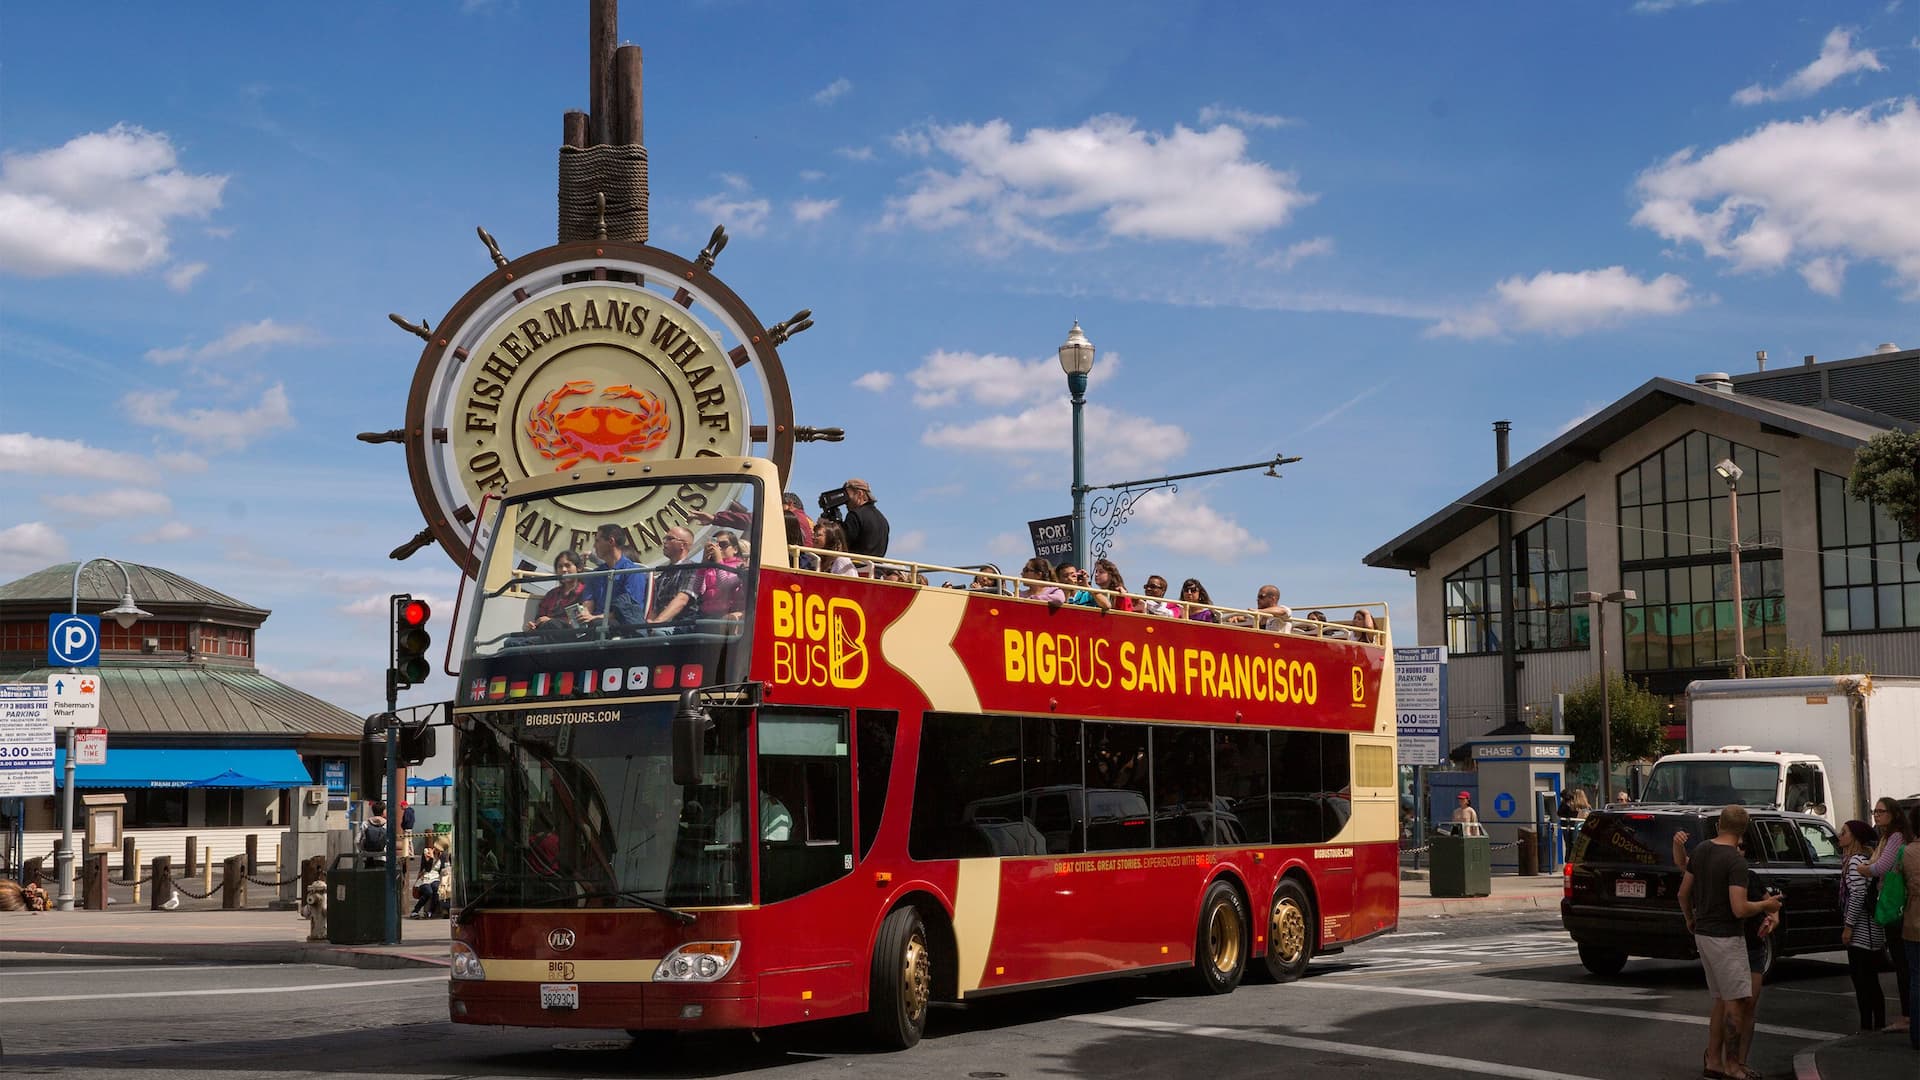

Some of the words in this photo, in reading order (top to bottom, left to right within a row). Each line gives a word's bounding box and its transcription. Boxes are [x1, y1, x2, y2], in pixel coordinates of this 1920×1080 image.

[466, 299, 649, 435] FISHERMANS
[650, 314, 731, 434] WHARF
[469, 451, 510, 491] OF
[1038, 524, 1066, 540] PORT
[1038, 546, 1050, 556] 150
[1051, 543, 1073, 554] YEARS
[773, 589, 827, 642] BIG
[774, 641, 828, 688] BUS
[1119, 641, 1176, 694] SAN
[1184, 648, 1318, 705] FRANCISCO
[53, 701, 95, 709] Fisherman's
[53, 709, 75, 717] Wharf
[526, 710, 621, 727] BIGBUSTOURS.COM
[1480, 747, 1512, 756] CHASE
[1534, 746, 1559, 756] CHASE
[1054, 861, 1075, 874] GREAT
[1097, 859, 1117, 871] GREAT
[1143, 856, 1181, 869] EXPERIENCED
[1181, 855, 1195, 866] WITH
[549, 961, 563, 971] BIG
